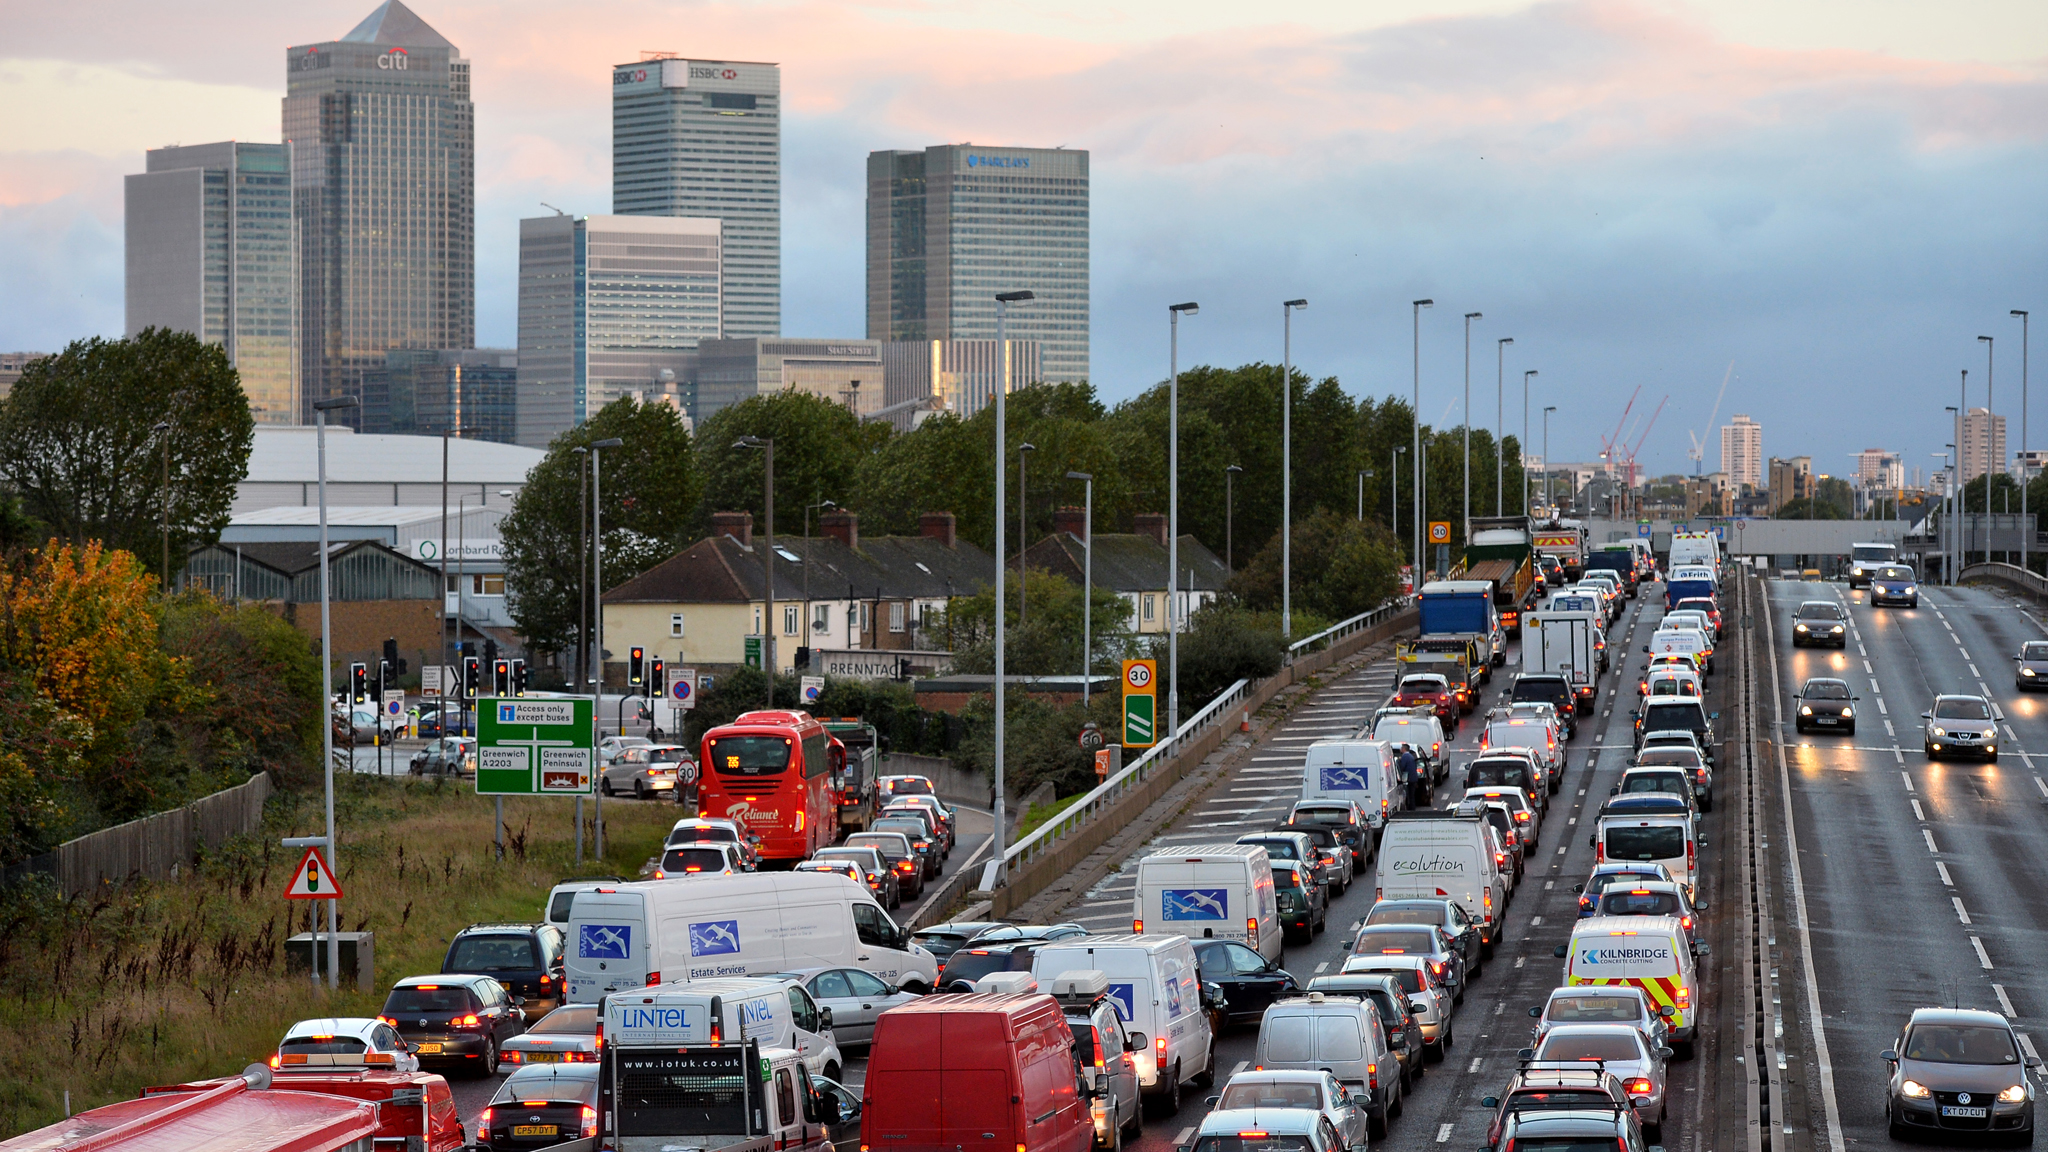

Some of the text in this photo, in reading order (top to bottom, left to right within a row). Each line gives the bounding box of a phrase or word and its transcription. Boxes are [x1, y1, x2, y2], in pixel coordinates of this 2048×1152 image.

[377, 50, 408, 70] citi
[613, 69, 635, 85] HSBC
[690, 67, 720, 79] HSBC
[980, 156, 1030, 168] BARCLAYS
[1434, 528, 1446, 536] 30
[446, 544, 489, 555] ombard
[1130, 670, 1149, 681] 30
[516, 704, 565, 714] Access only
[543, 750, 586, 758] Greenwich
[680, 768, 694, 778] 30
[726, 802, 779, 829] Reliance
[1394, 854, 1464, 872] ecolution
[1164, 891, 1173, 920] swan
[580, 925, 588, 958] swan
[690, 924, 700, 957] swan
[1600, 949, 1668, 958] KILNBRIDGE
[691, 965, 746, 978] Estate Services
[888, 970, 898, 978] 225
